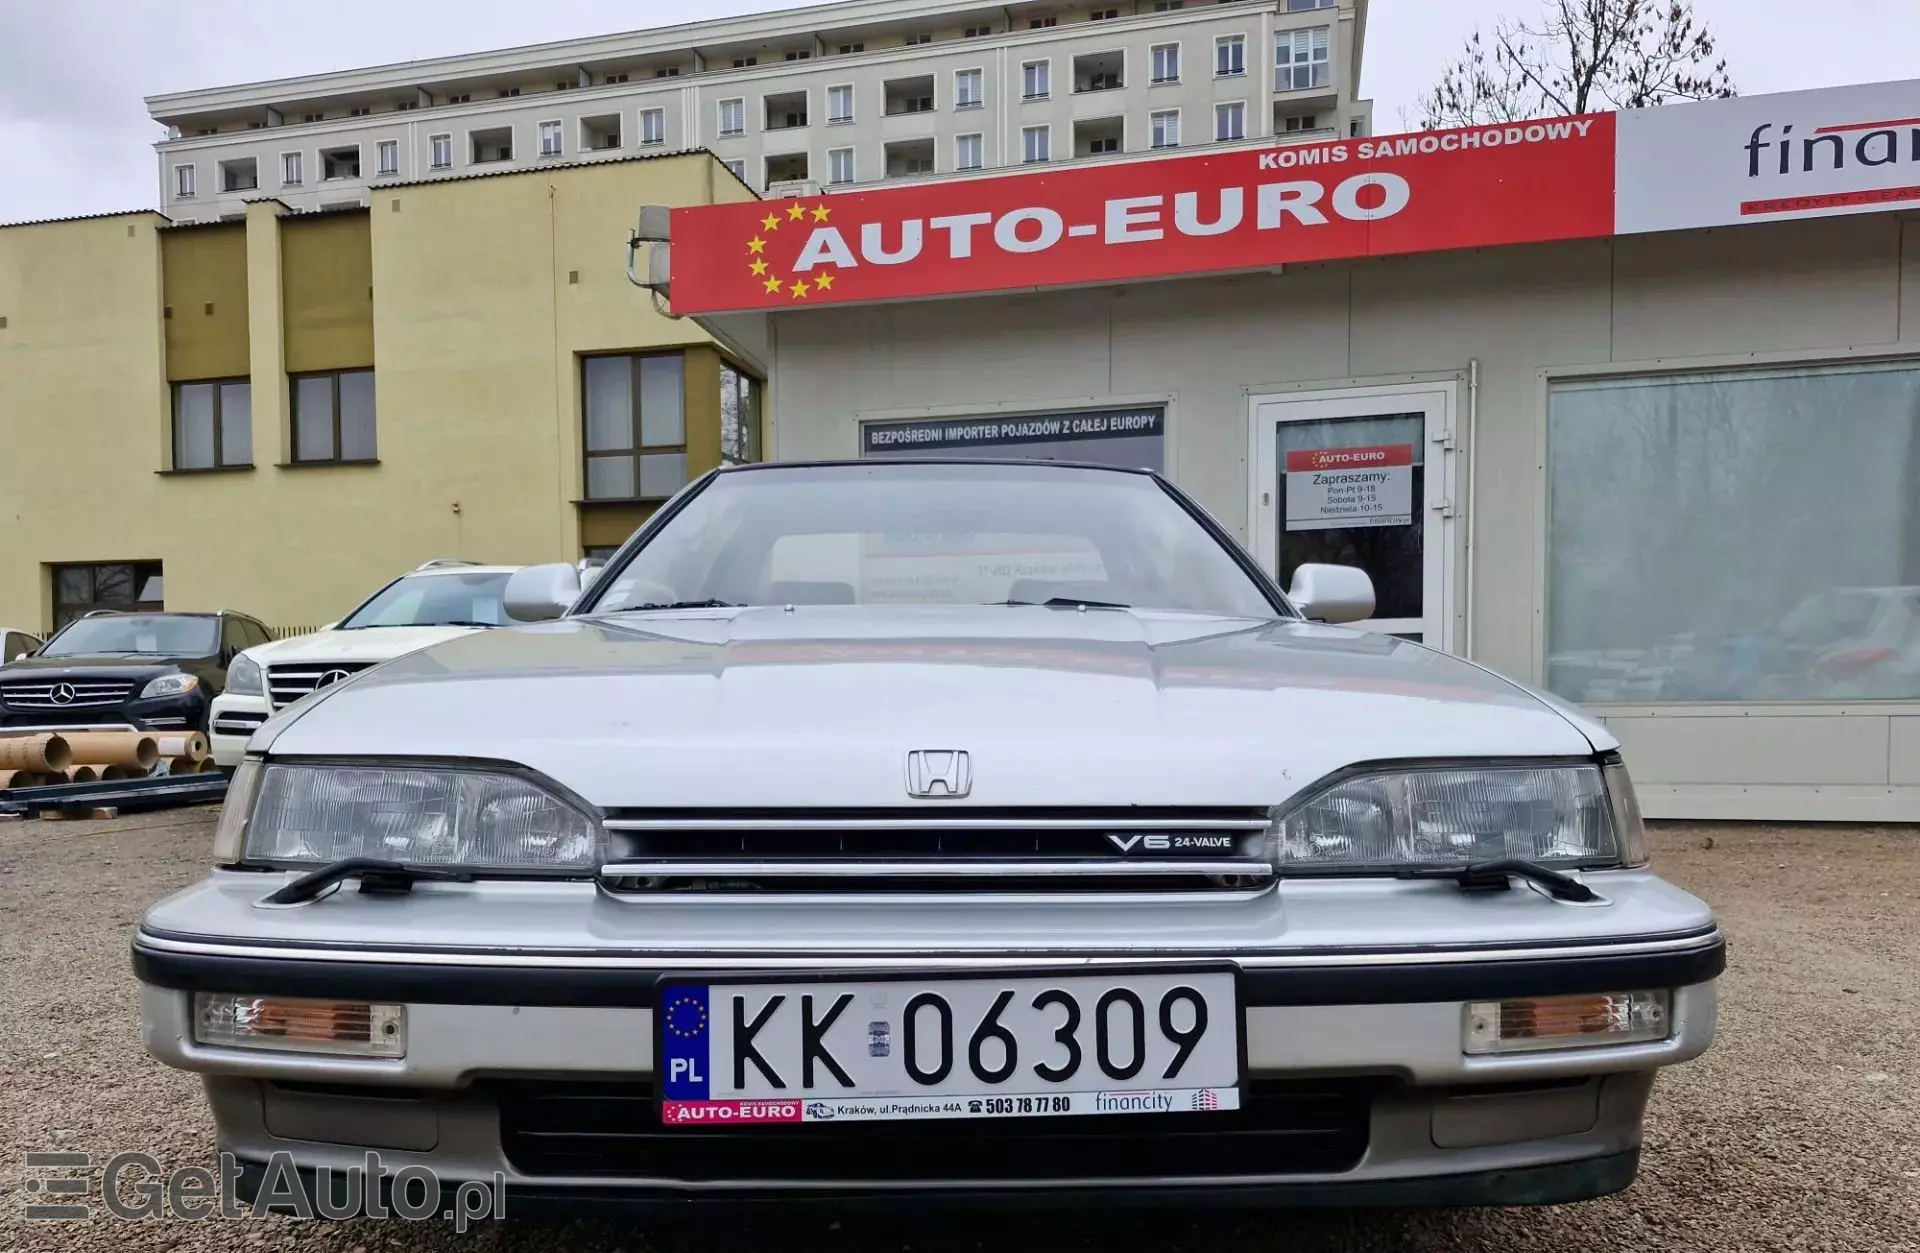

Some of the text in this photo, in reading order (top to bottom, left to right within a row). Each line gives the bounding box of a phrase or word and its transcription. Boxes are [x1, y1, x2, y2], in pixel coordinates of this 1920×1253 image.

[1259, 119, 1594, 170] KOMIS SAMOCHODOWY
[1744, 122, 1920, 178] fina
[792, 173, 1411, 272] AUTO-EURO
[871, 415, 1156, 445] BEZPOŚREDNI IMPORTER POJAZDÓW Z CAŁEJ EUROPY
[1319, 451, 1385, 464] AUTO-EURO
[1312, 471, 1391, 486] Zapraszamy:
[1327, 494, 1377, 504] Sobota 9-15
[1357, 485, 1376, 493] 9-18
[1320, 503, 1383, 514] Niedziela 10-15
[1108, 835, 1231, 851] V6 24-VALVE
[733, 986, 1208, 1090] KK 06309
[670, 1058, 704, 1083] PL
[677, 1106, 796, 1119] AUTO-EURO
[837, 1090, 1173, 1115] Kraków, ul.Prądnicka 44A 503 78 77 80 financity
